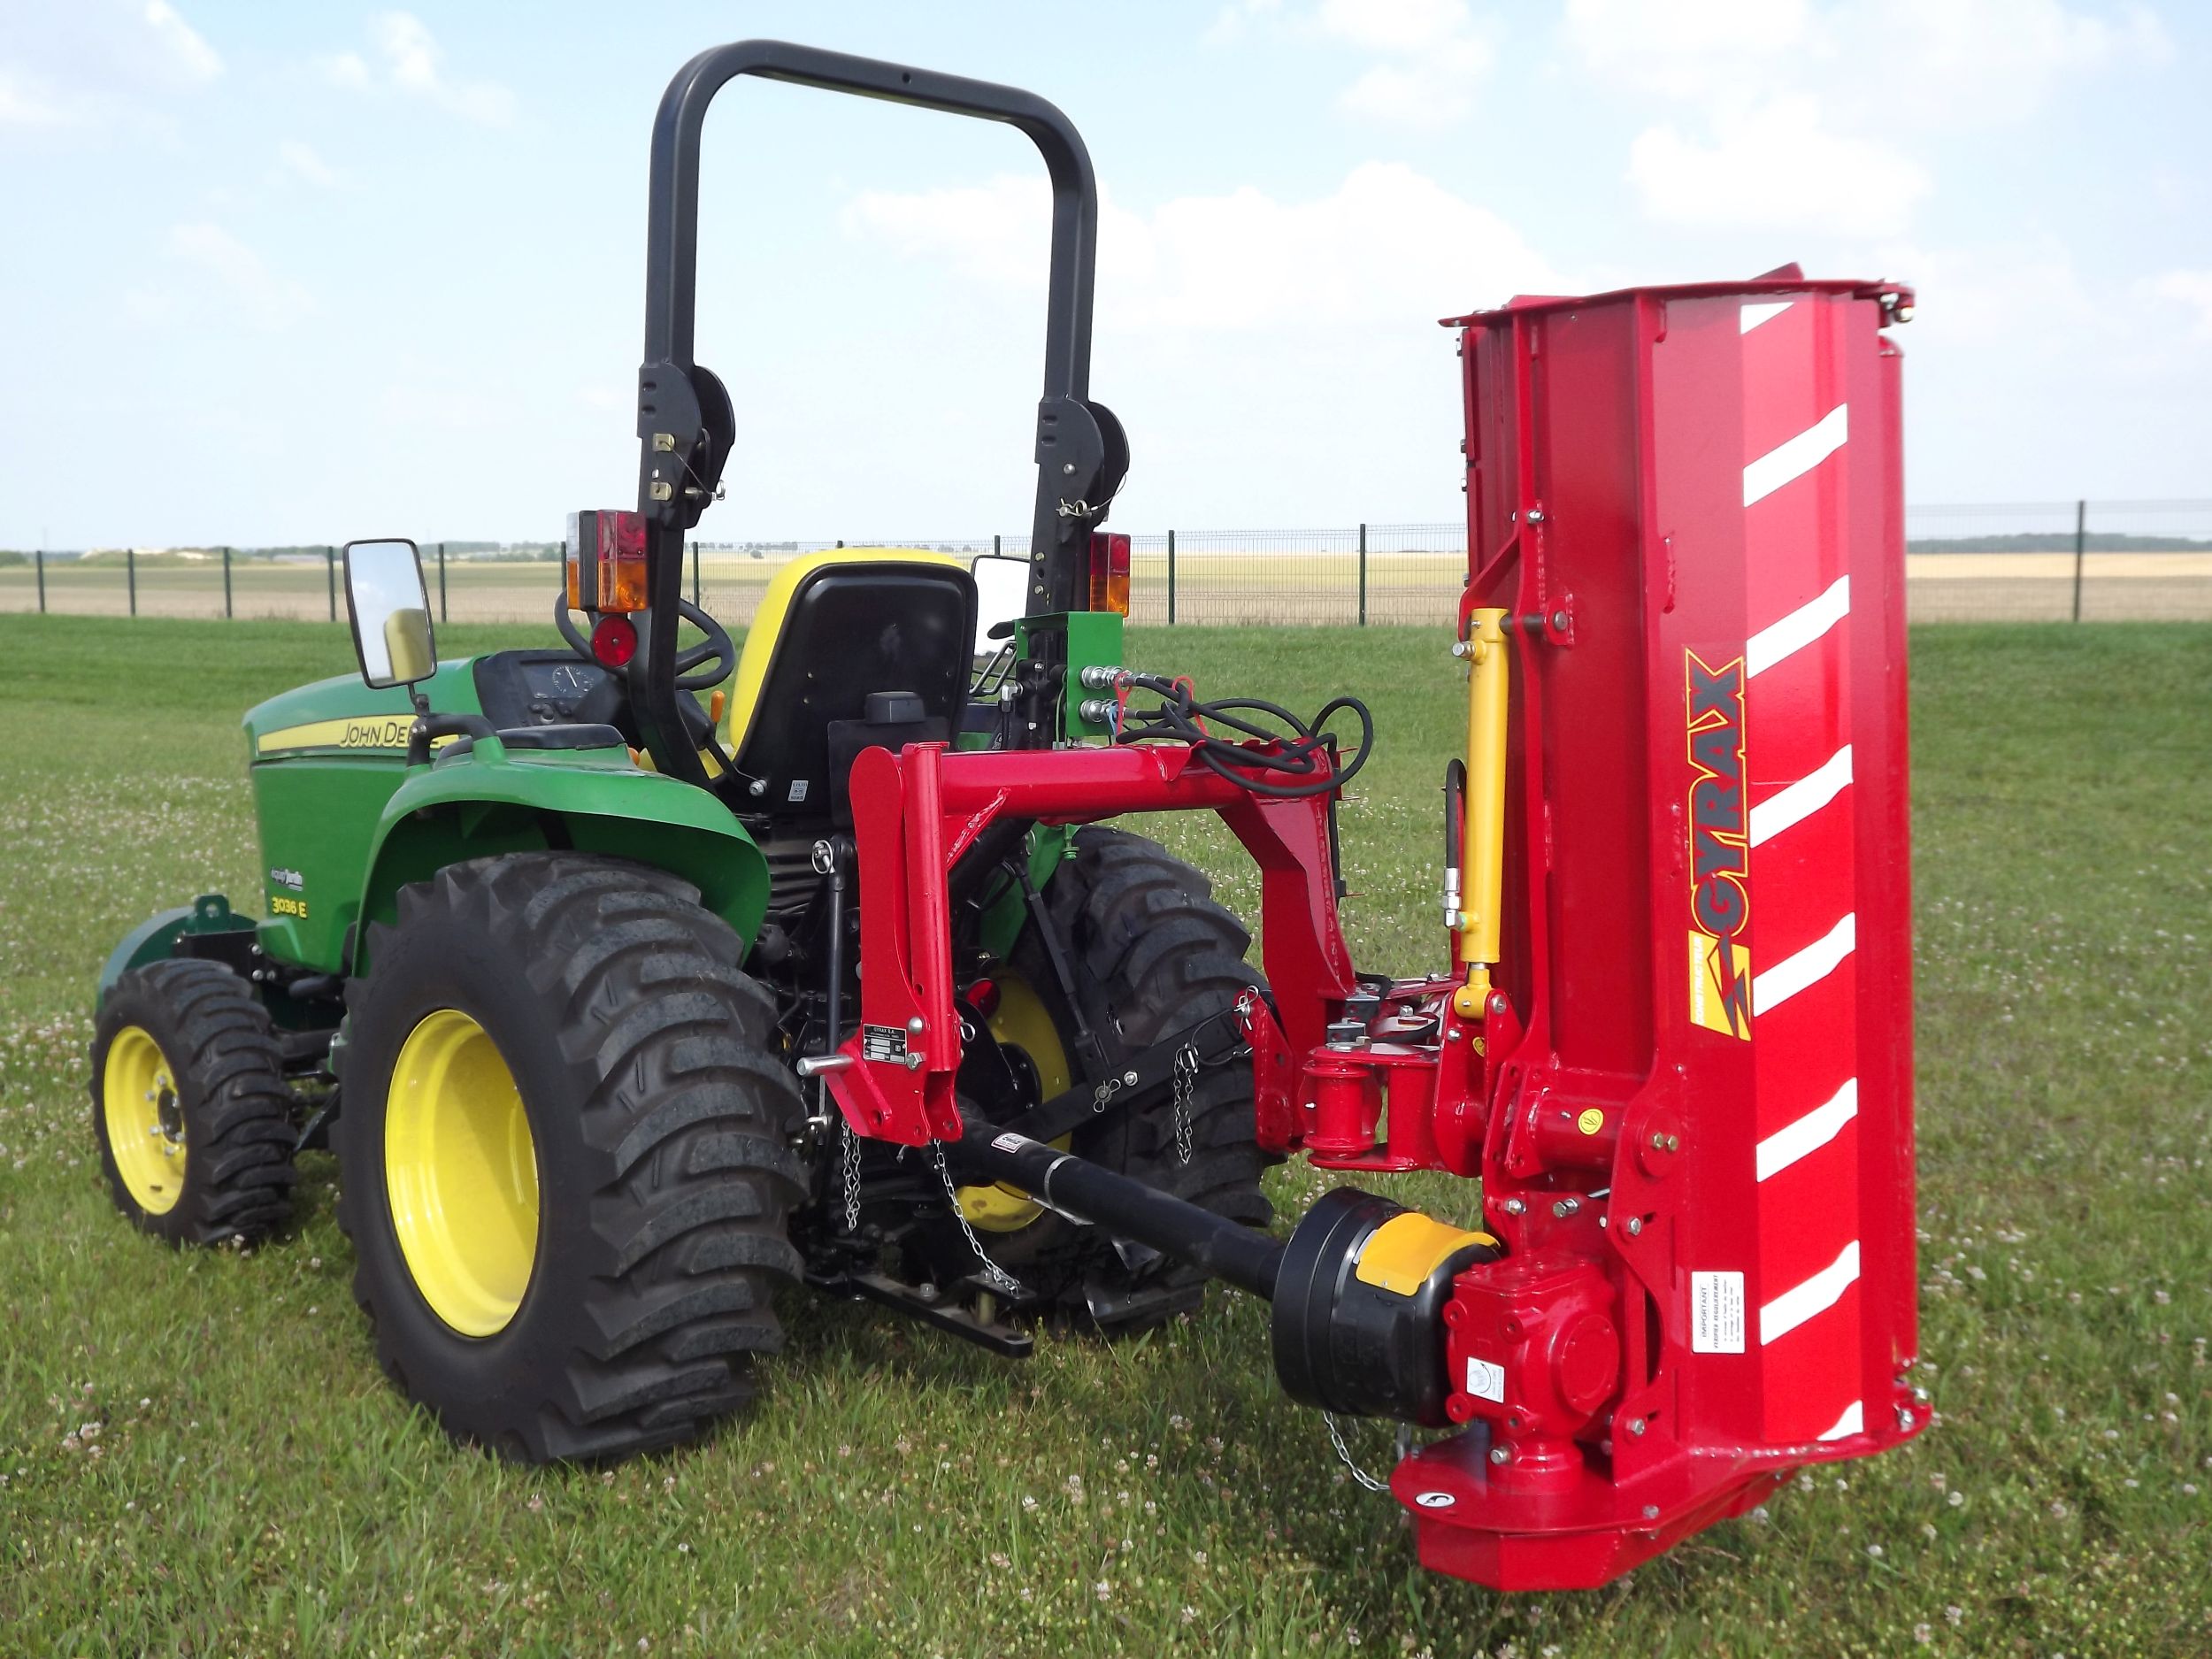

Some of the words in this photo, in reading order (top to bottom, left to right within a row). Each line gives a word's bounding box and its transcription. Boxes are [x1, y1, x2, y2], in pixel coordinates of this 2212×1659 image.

[341, 722, 381, 744] JOHN
[1691, 670, 1742, 935] GYRAX
[272, 895, 297, 915] 3036
[298, 901, 307, 918] E
[1694, 936, 1704, 1025] CONSTRUCTEUR
